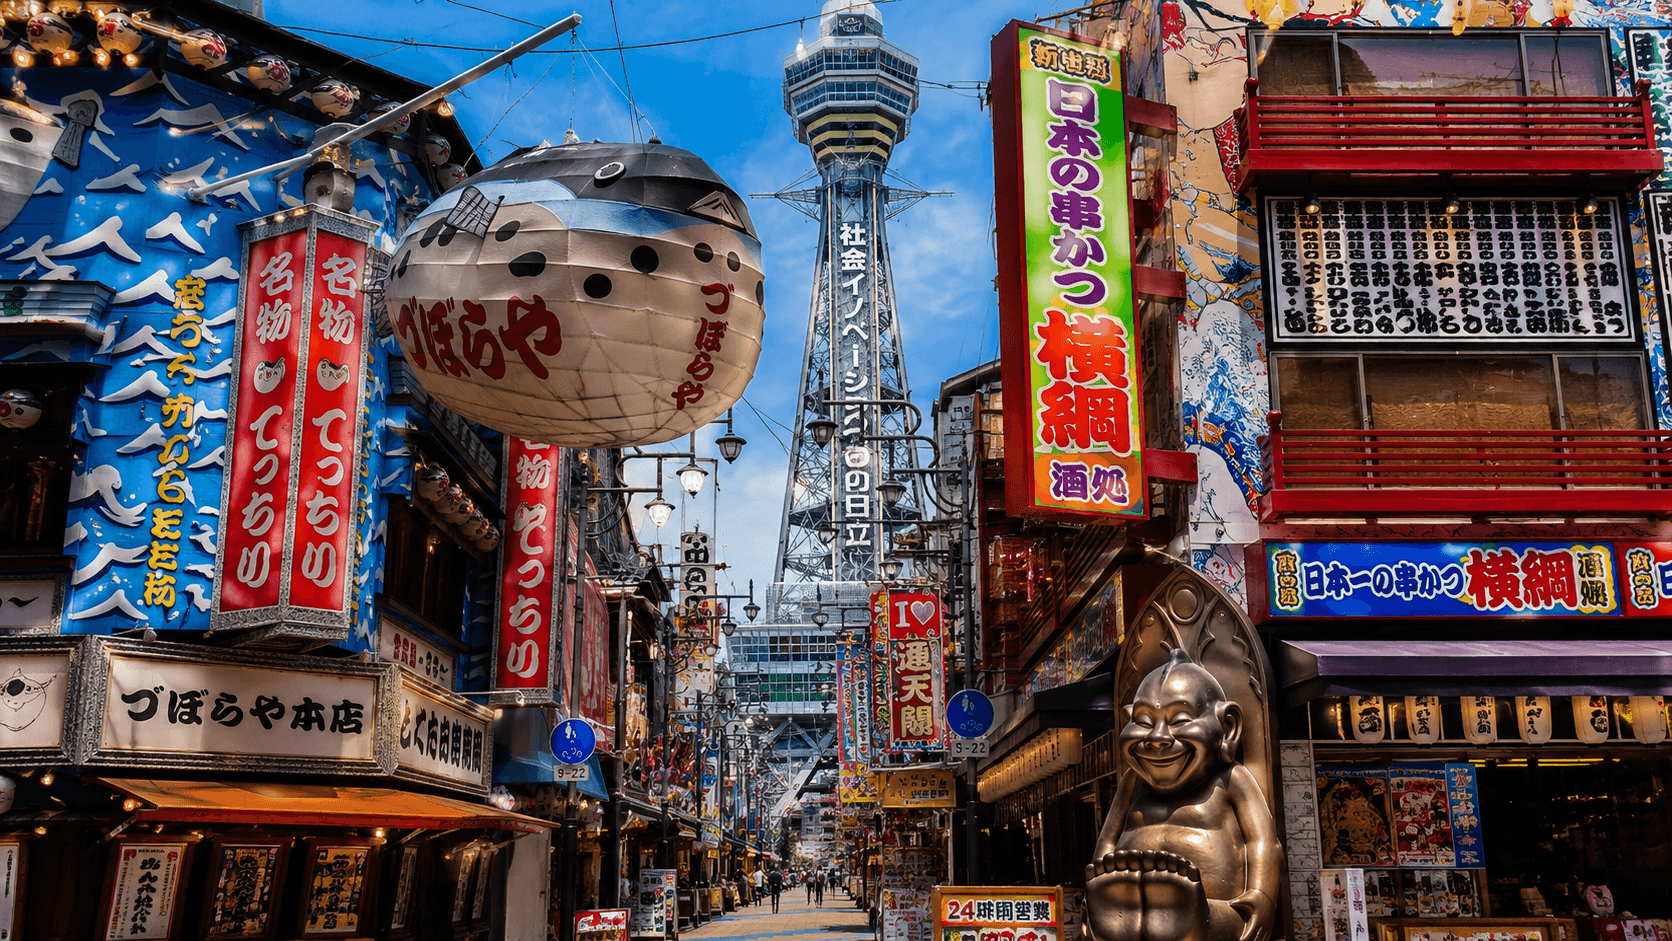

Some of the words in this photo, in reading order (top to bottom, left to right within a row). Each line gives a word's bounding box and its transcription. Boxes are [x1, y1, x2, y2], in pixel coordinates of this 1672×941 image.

[398, 294, 562, 380] づぼらや
[671, 282, 735, 410] づぼらや
[895, 601, 911, 628] I
[120, 684, 365, 735] づぼらや本店
[557, 767, 586, 779] 9-22
